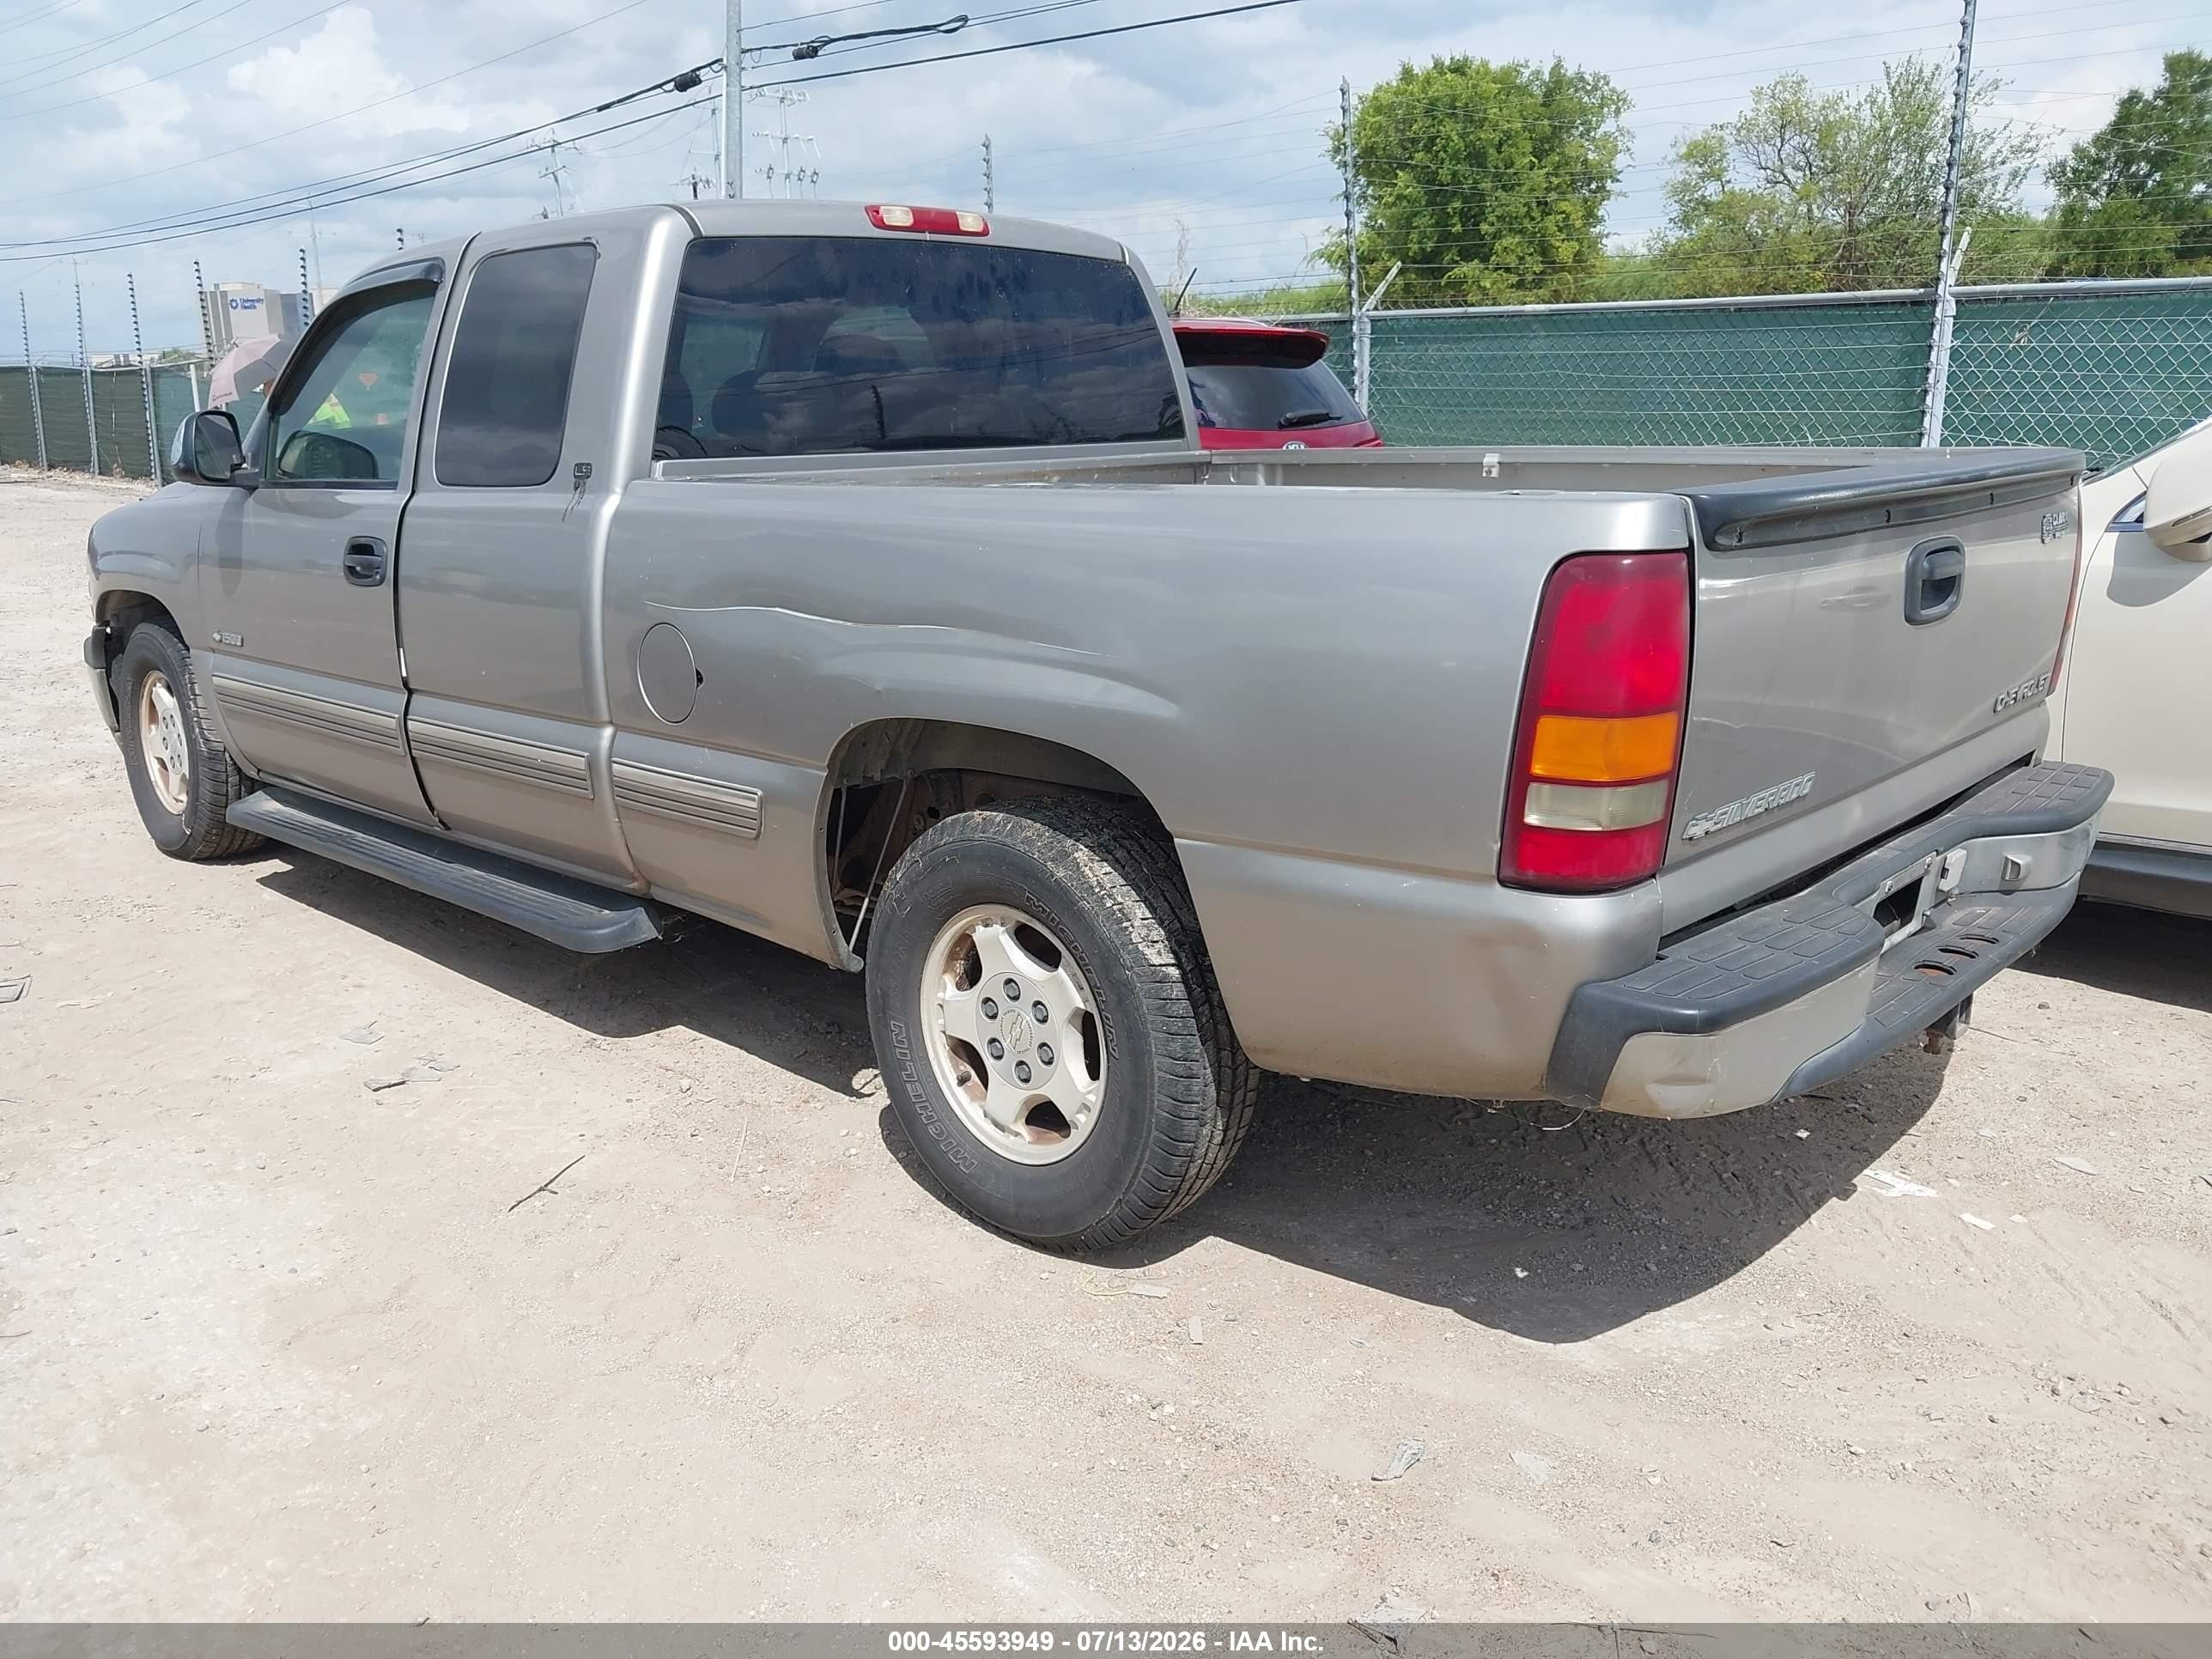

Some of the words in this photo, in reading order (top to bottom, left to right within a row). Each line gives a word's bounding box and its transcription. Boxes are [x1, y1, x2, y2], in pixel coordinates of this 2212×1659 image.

[1710, 771, 1817, 832] SILVERADO
[1024, 889, 1120, 1060] MICHELIN
[890, 1019, 978, 1174] MICHELIN
